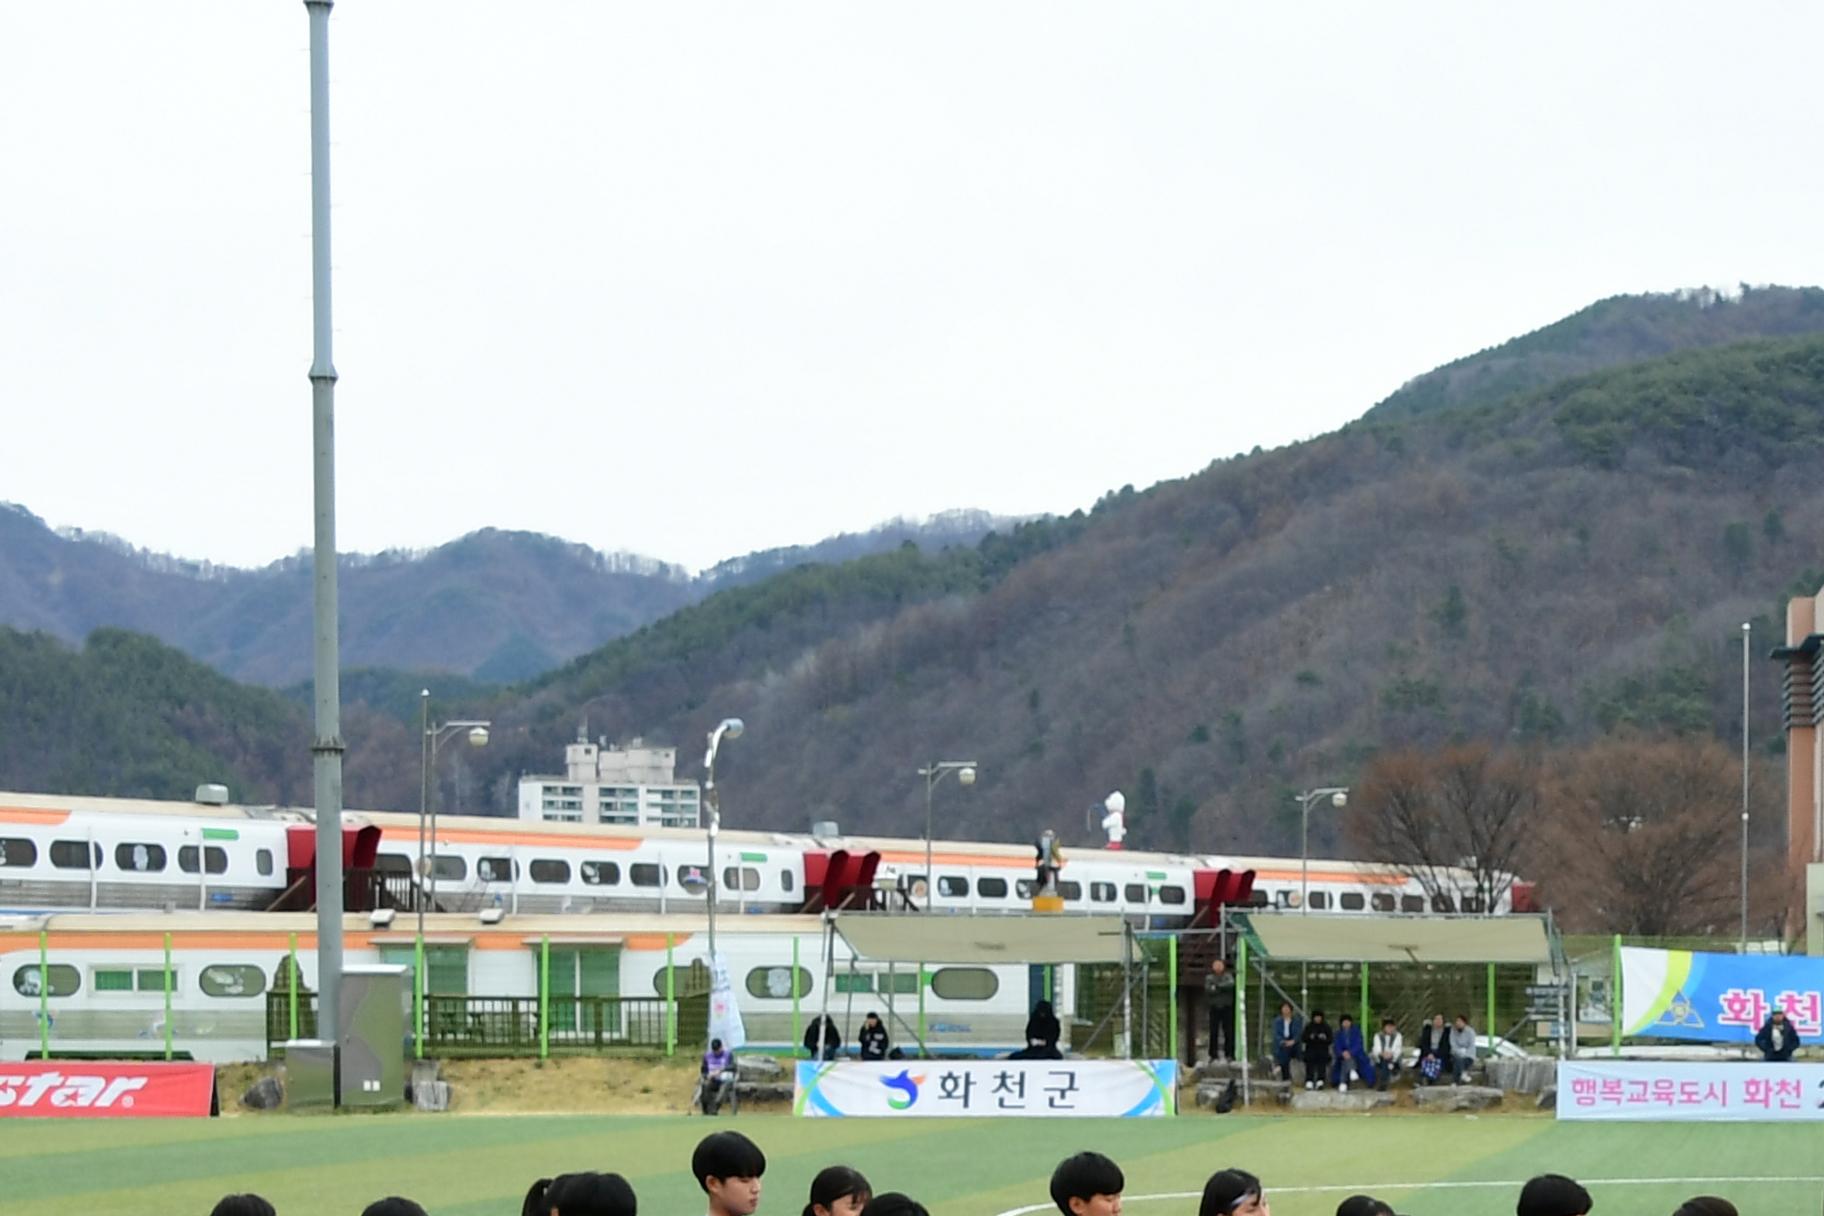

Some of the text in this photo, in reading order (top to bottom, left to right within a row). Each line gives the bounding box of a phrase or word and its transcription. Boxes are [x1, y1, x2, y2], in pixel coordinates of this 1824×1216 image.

[937, 1070, 1080, 1109] 화천군
[1571, 1077, 1728, 1107] 행복교육도시
[1743, 1077, 1802, 1109] 화천
